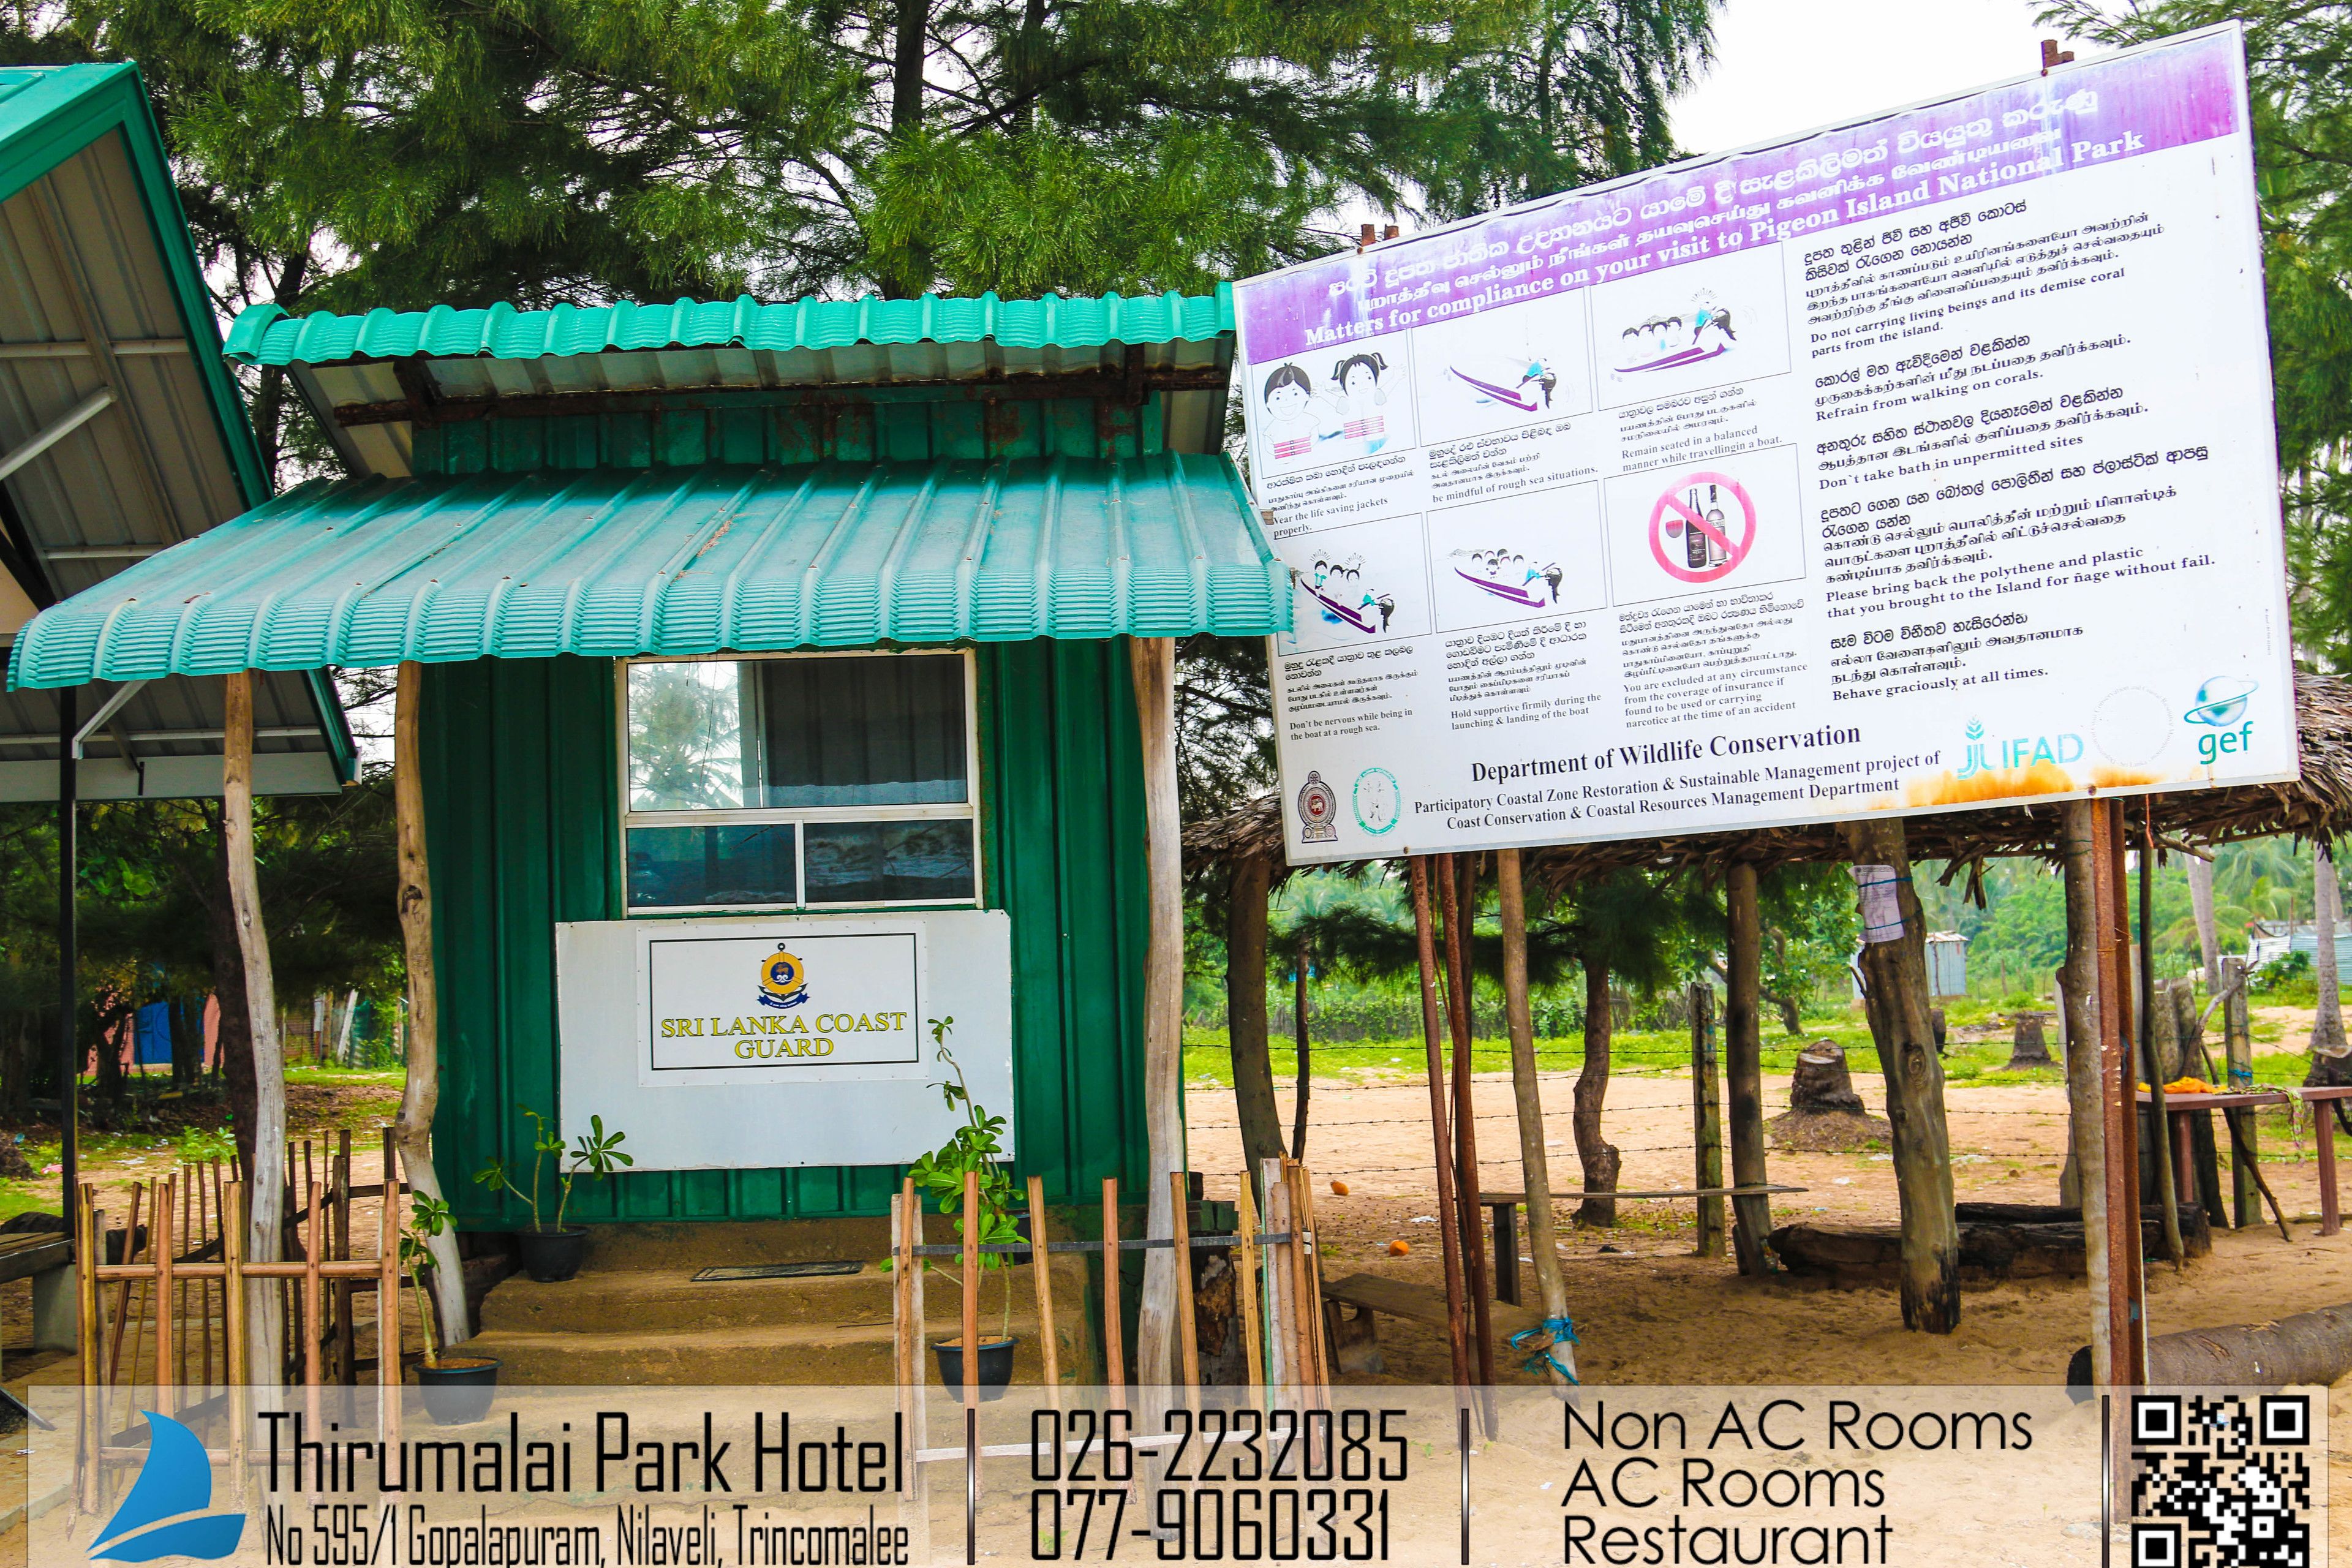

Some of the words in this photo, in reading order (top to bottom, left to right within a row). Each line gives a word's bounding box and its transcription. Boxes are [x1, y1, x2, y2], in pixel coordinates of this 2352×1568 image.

[1305, 317, 1384, 345] Matters
[1389, 309, 1422, 327] for
[1427, 277, 1555, 319] compliance
[1559, 267, 1589, 286] on
[1594, 252, 1652, 284] your
[1656, 235, 1711, 262] visit
[1717, 228, 1744, 249] to
[1749, 208, 1840, 242] Pigeon
[1845, 179, 1931, 219] Island
[1937, 147, 2065, 196] National
[2070, 130, 2146, 164] Park
[1811, 333, 1827, 343] Do
[1831, 327, 1851, 339] not
[1855, 315, 1905, 333] carrying
[1909, 307, 1944, 322] living
[1948, 298, 1988, 314] beings
[1991, 290, 2016, 304] and
[2020, 288, 2036, 298] its
[2040, 277, 2086, 293] demise
[2090, 267, 2125, 283] coral
[1811, 344, 1841, 359] parts
[1845, 337, 1875, 350] from
[1879, 333, 1898, 343] the
[1902, 321, 1943, 337] island.
[1815, 367, 1860, 388] කොරල්
[1866, 364, 1890, 378] මත
[1895, 346, 1963, 374] ඇවිදීමෙන්
[1970, 334, 2030, 356] වළකින්න
[1815, 403, 1869, 421] Refrain
[1872, 398, 1907, 410] from
[1910, 385, 1969, 402] walking
[1972, 381, 1991, 391] on
[1995, 369, 2043, 386] corals.
[1622, 445, 1657, 459] Remain
[1660, 438, 1690, 451] seated
[1693, 437, 1702, 445] in
[1714, 425, 1757, 441] balanced
[1623, 459, 1659, 472] manner
[1661, 453, 1687, 464] while
[1757, 436, 1782, 447] boat.
[1863, 469, 1894, 482] take
[1898, 461, 1931, 475] bath
[1933, 458, 1950, 471] in
[1953, 440, 2046, 466] unpermitted
[2049, 436, 2083, 448] sites
[1295, 512, 1308, 521] the
[1310, 508, 1324, 518] life
[1326, 504, 1355, 514] saving
[1357, 498, 1388, 511] jackets
[1274, 524, 1313, 540] properly.
[1826, 590, 1868, 602] Please
[1872, 582, 1910, 595] bring
[1913, 575, 1948, 589] back
[1952, 572, 1976, 584] the
[1980, 562, 2054, 583] polythene
[2059, 554, 2088, 568] and
[2092, 546, 2144, 567] plastic
[1827, 606, 1856, 618] that
[1859, 604, 1885, 617] you
[1888, 593, 1946, 609] brought
[1950, 592, 1964, 601] to
[1968, 587, 1992, 598] the
[1996, 578, 2042, 594] Island
[2046, 576, 2070, 587] for
[2073, 571, 2110, 584] ñage
[2114, 560, 2177, 577] without
[2181, 554, 2215, 568] fail.
[1662, 674, 1704, 688] excluded
[1719, 673, 1736, 681] any
[1740, 665, 1807, 677] circumstance
[1832, 688, 1882, 701] Behave
[1886, 677, 1958, 695] graciously
[1962, 675, 1977, 685] at
[1981, 671, 2000, 683] all
[2003, 668, 2048, 680] times.
[1325, 717, 1355, 726] nervous
[1357, 712, 1379, 721] while
[1381, 710, 1403, 719] being
[1340, 725, 1363, 735] rough
[1471, 753, 1588, 785] Department
[1594, 748, 1615, 770] of
[1618, 739, 1703, 766] Wildlife
[1709, 725, 1861, 756] Conservation
[2002, 733, 2084, 769] IFAD
[2198, 720, 2254, 765] gef
[1414, 798, 1493, 814] Participatory
[1496, 790, 1543, 806] Coastal
[1547, 789, 1578, 802] Zone
[1582, 780, 1659, 799] Restoration
[1662, 777, 1675, 791] &
[1679, 769, 1760, 789] Sustainable
[1765, 760, 1861, 781] Management
[1866, 755, 1920, 775] project
[1924, 750, 1941, 766] of
[1447, 816, 1481, 830] Coast
[1483, 809, 1566, 826] Conservation
[1570, 806, 1582, 820] &
[1586, 801, 1635, 818] Coastal
[1638, 797, 1707, 813] Resources
[1711, 787, 1804, 807] Management
[1809, 778, 1899, 801] Department
[660, 1018, 703, 1038] SRI
[711, 1014, 809, 1037] LANKA
[815, 1011, 908, 1034] COAST
[734, 1037, 835, 1059] GUARD
